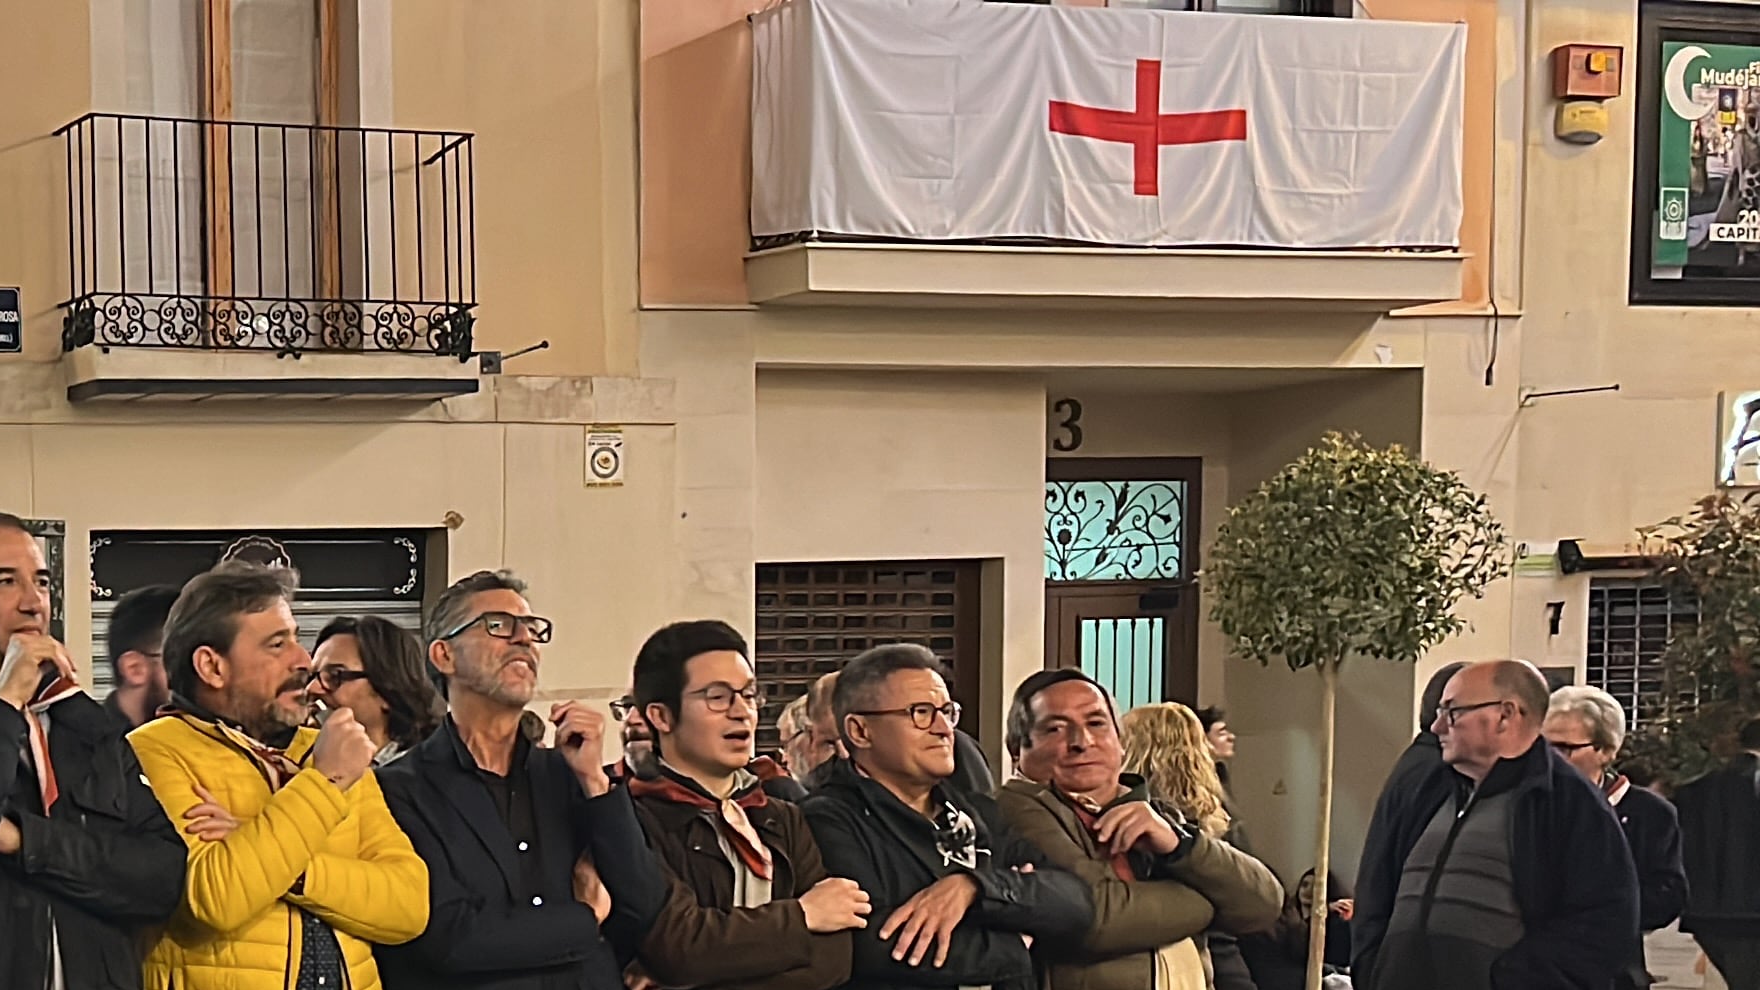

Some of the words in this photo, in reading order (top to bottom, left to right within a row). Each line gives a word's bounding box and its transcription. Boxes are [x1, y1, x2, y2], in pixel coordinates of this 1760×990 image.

[1701, 67, 1760, 90] Mudéja
[1717, 226, 1760, 240] CAPIT
[1053, 398, 1082, 451] 3
[1546, 601, 1565, 635] 7
